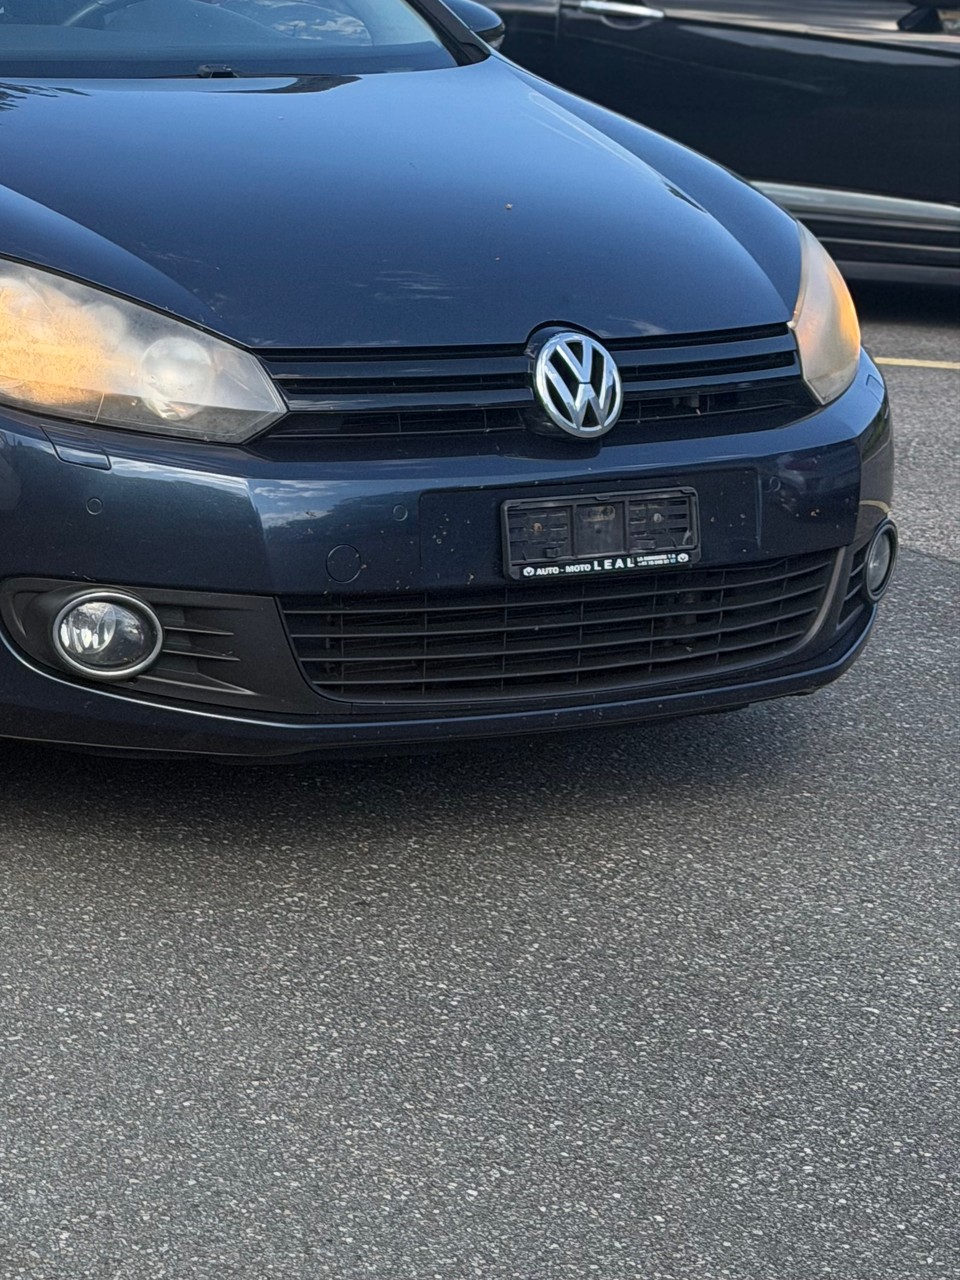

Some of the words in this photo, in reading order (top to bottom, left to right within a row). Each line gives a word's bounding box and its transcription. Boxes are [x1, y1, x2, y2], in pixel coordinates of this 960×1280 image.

[536, 332, 621, 438] VW
[536, 566, 559, 576] AUTO
[565, 564, 591, 573] MOTO
